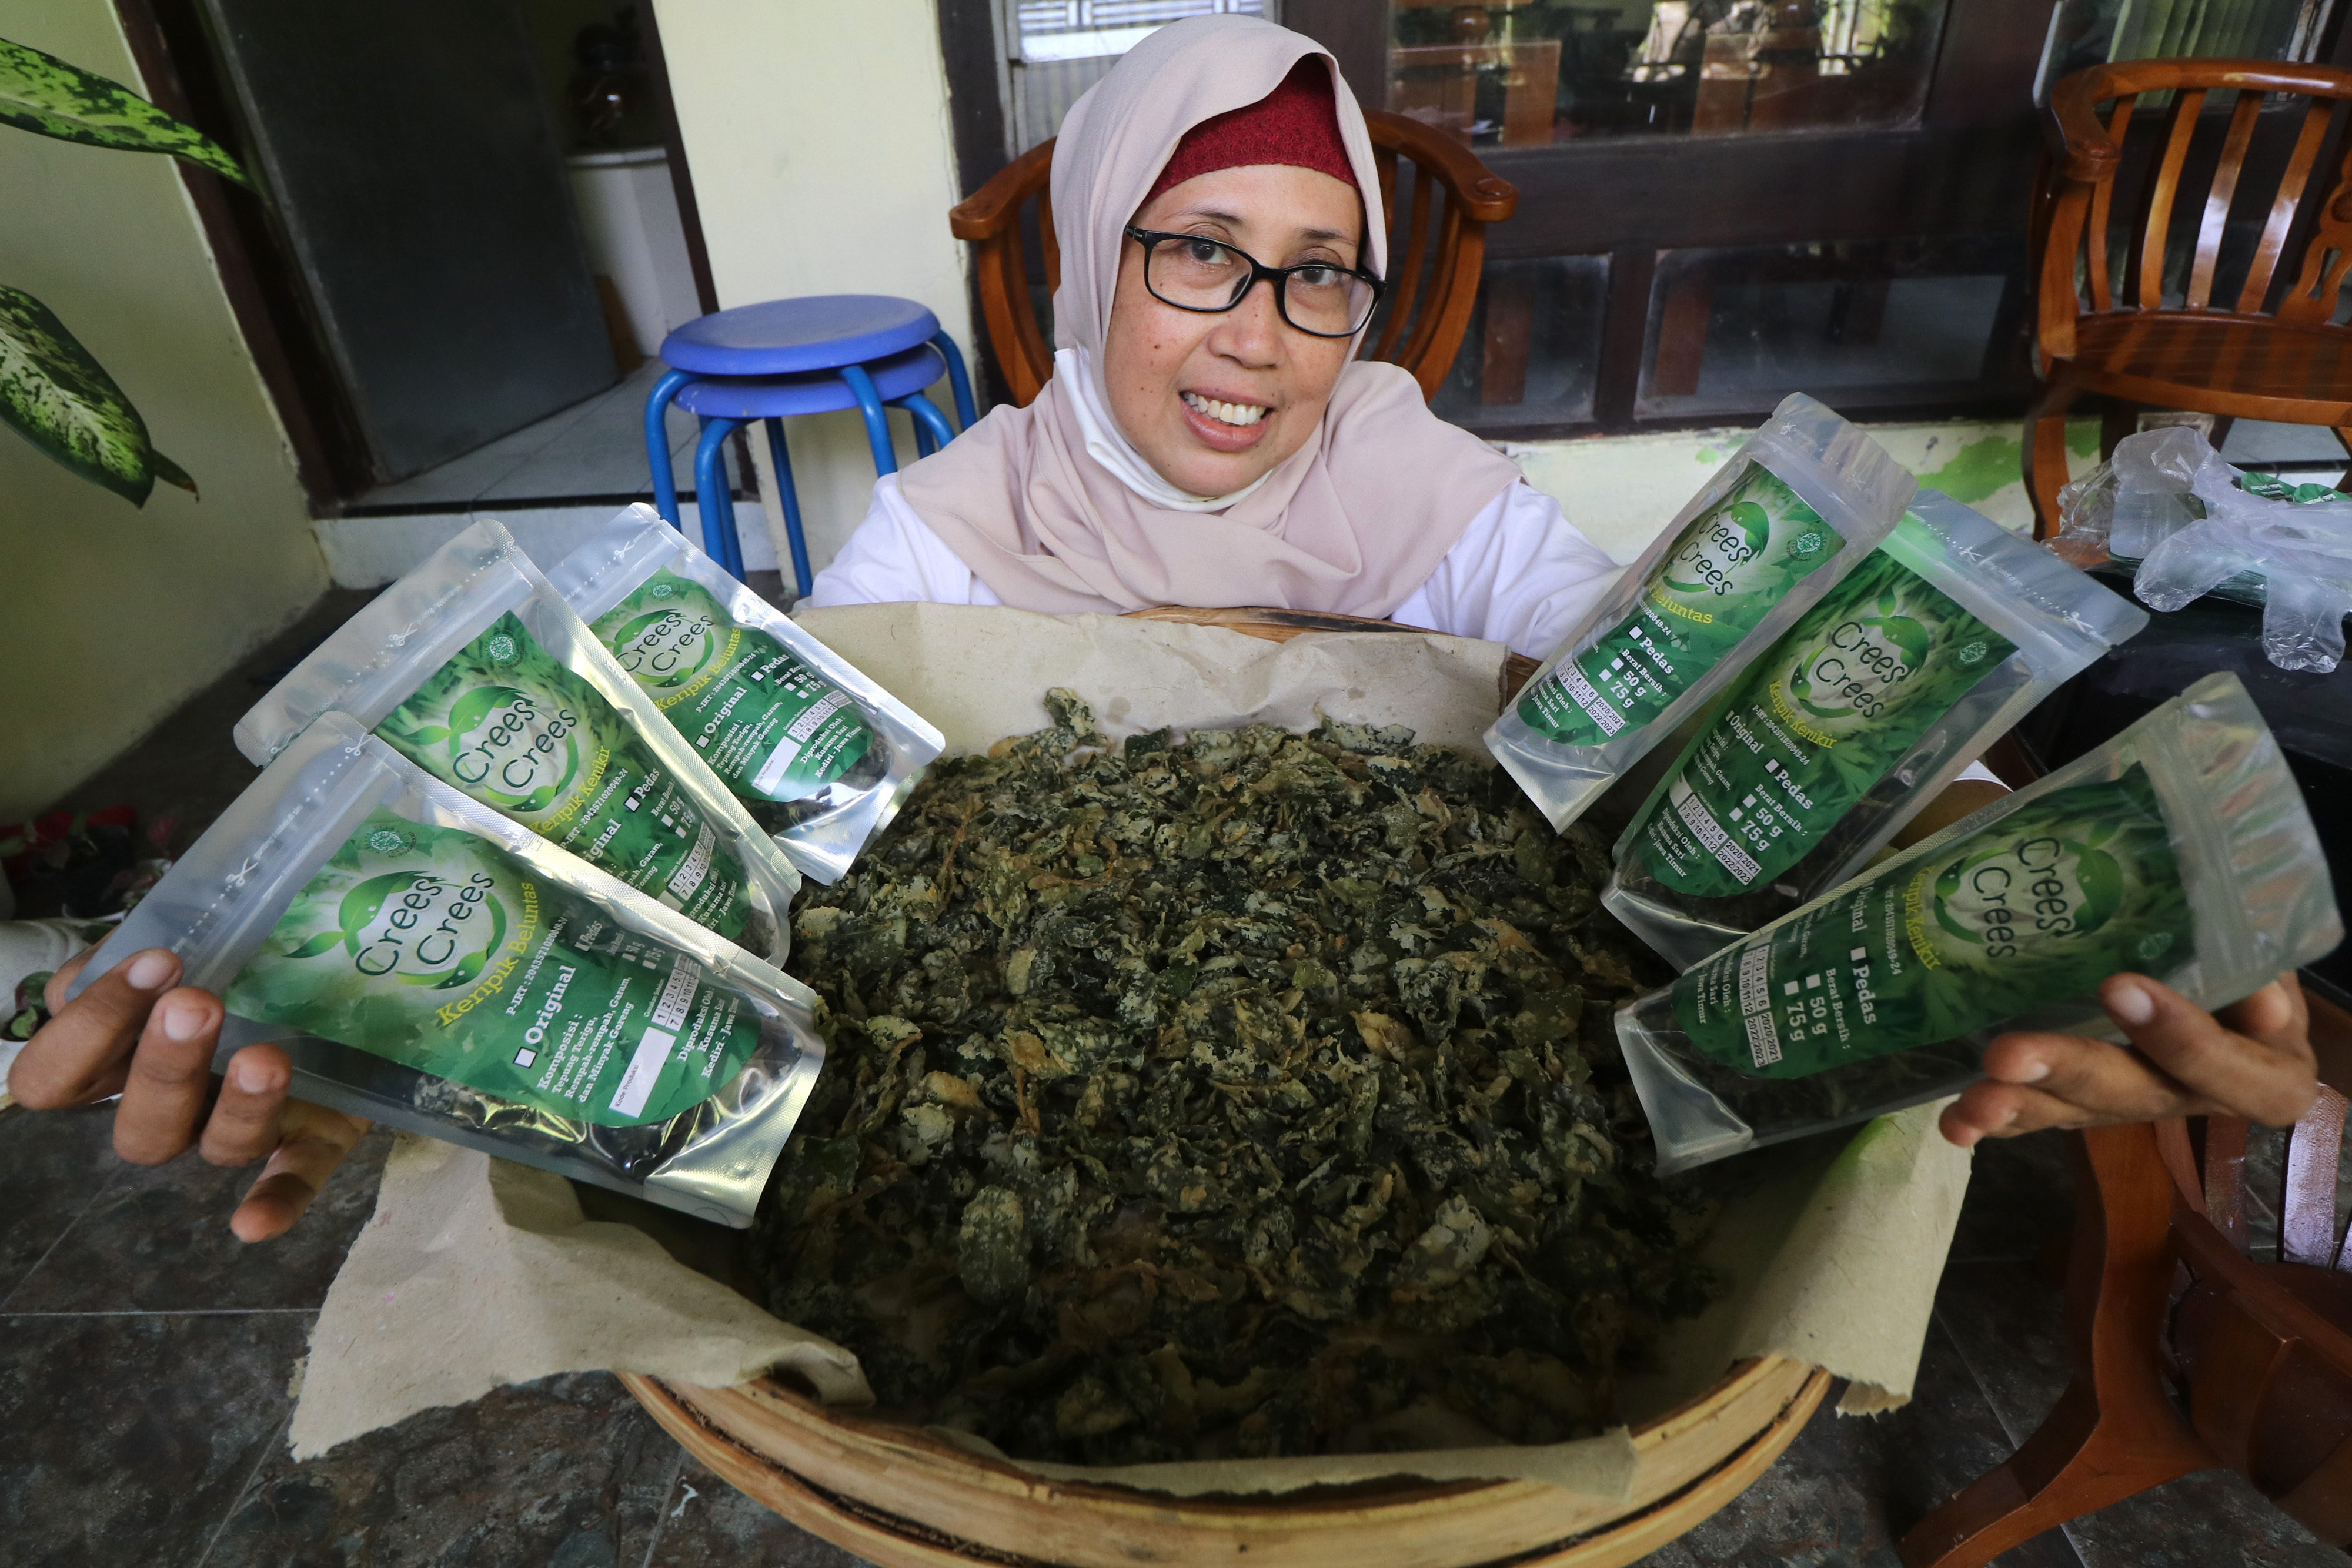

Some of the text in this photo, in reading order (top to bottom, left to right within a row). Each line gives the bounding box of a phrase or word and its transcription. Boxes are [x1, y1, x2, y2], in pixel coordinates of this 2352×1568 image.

[1698, 513, 1750, 565] Crees
[1679, 541, 1733, 597] Crees
[1651, 587, 1715, 624] Beluntas
[617, 611, 682, 671] Crees
[651, 614, 714, 674] Crees
[760, 651, 790, 674] Pedas
[1638, 636, 1676, 676] Pedas
[1830, 618, 1904, 687] Crees
[653, 626, 741, 710] Keripik Beluntas
[774, 670, 792, 686] Berat
[794, 671, 807, 684] 50
[1609, 680, 1629, 700] 75
[1621, 648, 1664, 693] Berat Bersih
[1622, 670, 1647, 699] 50 g
[1815, 655, 1885, 721] Crees
[702, 684, 748, 736] Original
[1531, 694, 1545, 710] Jawa
[1541, 707, 1561, 730] Timur
[1546, 697, 1560, 713] Sari
[1554, 692, 1571, 710] Oleh
[1587, 706, 1616, 735] 2022 2023
[1595, 698, 1624, 728] 2020 2021
[1770, 680, 1838, 748] Keripik Kenikir
[451, 700, 536, 787] Crees
[500, 708, 579, 791] Crees
[707, 721, 740, 765] Komposisi
[716, 721, 753, 770] Tepung Terigu,
[723, 700, 783, 774] Rempah-rempah, Garam,
[731, 717, 779, 779] dan Minyak Goreng
[800, 727, 831, 765] Diproduksi
[814, 733, 839, 761] Kusuma
[835, 723, 848, 735] Sari
[814, 724, 863, 778] Kediri Jawa Timur
[1726, 714, 1765, 755] Original
[528, 744, 611, 833] Keripik Kenikir
[633, 767, 660, 800] Pedas
[1713, 769, 1733, 791] Garam,
[1773, 768, 1816, 811] Pedas
[650, 796, 667, 817] Berat
[668, 801, 682, 814] 50
[1754, 783, 1804, 833] Berat Bersih
[1754, 807, 1784, 840] 50 g
[582, 817, 622, 862] iginal
[1656, 821, 1686, 860] Kusuma Sari
[1679, 836, 1698, 855] Oleh
[1740, 819, 1763, 843] 75
[639, 840, 663, 868] Garam,
[1653, 839, 1668, 857] Jawa
[1664, 853, 1687, 878] Timur
[1716, 850, 1751, 884] 2022 2023
[1725, 841, 1760, 875] 2020 2021
[686, 881, 717, 921] iproduksi
[697, 890, 723, 924] Kusuma
[717, 895, 733, 916] Jawa
[2016, 837, 2072, 935] Crees
[354, 874, 442, 982] Crees
[415, 869, 494, 970] Crees
[1972, 865, 2017, 960] Crees
[436, 881, 539, 1027] Keripik Beluntas
[1905, 916, 1941, 970] Kenikir
[505, 984, 528, 1017] P-IRT
[522, 961, 579, 1048] Original
[1697, 974, 1706, 1024] Jawa Timur
[1709, 986, 1718, 1005] Sari
[1722, 983, 1731, 1007] Oleh
[1786, 1002, 1806, 1027] 75
[1809, 996, 1829, 1035] 50 g
[1825, 968, 1850, 1042] Berat Bersih
[1852, 965, 1879, 1024] Pedas
[563, 1007, 617, 1100] Rempah-rempah,
[608, 974, 632, 1009] Garam,
[576, 1001, 634, 1104] dan Minyak Goreng
[677, 1004, 710, 1063] Diproduksi
[697, 1010, 722, 1053] Kusuma
[700, 1039, 725, 1079] Kediri
[721, 1012, 737, 1037] Jawa
[1747, 1018, 1765, 1065] 2022 2023
[1760, 1014, 1779, 1061] 2020 2021
[536, 1017, 581, 1091] Komposisi
[552, 1014, 599, 1095] Tepung Terigu,
